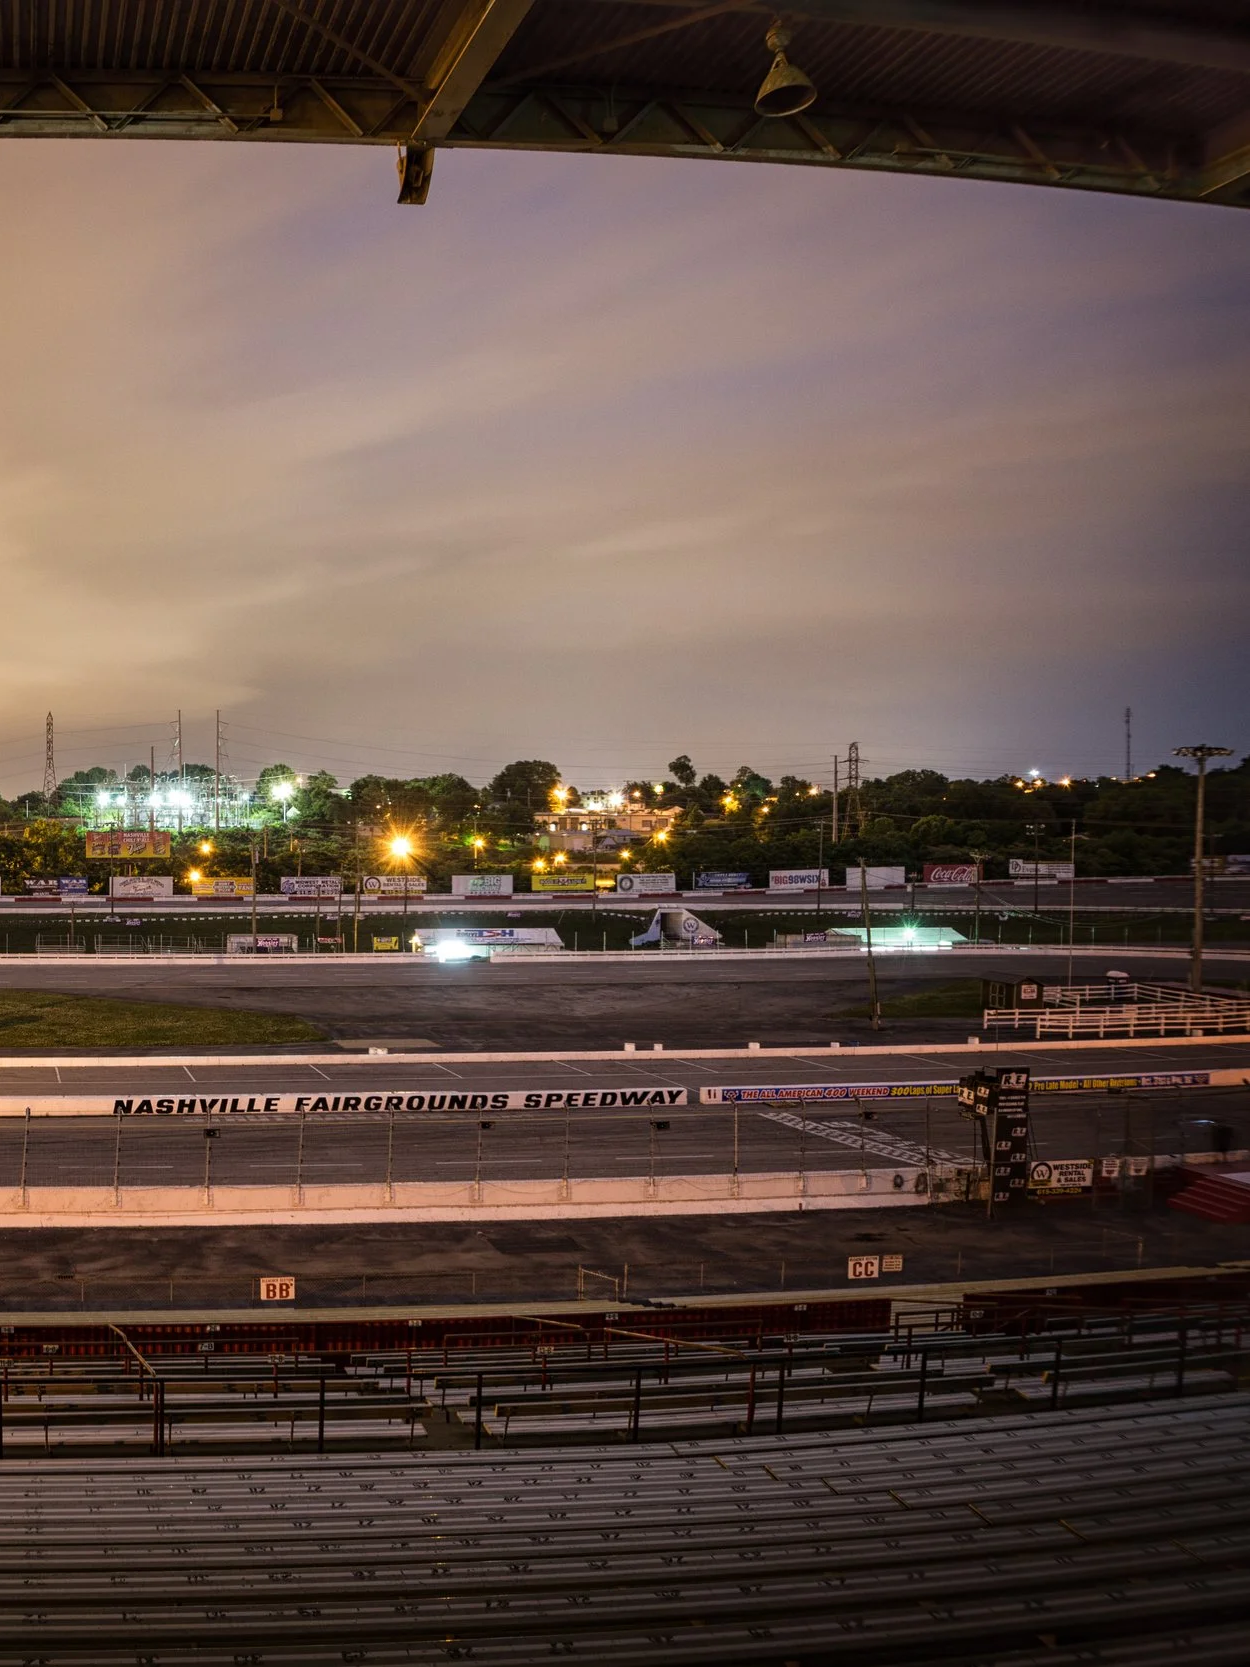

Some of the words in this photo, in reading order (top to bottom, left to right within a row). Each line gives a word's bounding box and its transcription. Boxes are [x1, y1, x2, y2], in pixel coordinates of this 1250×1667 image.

[741, 1090, 759, 1099] THE
[760, 1089, 776, 1098] ALL
[777, 1088, 823, 1099] AMERICAN
[824, 1088, 847, 1097] 400
[849, 1087, 890, 1098] WEEKEND
[113, 1097, 278, 1115] NASHVILLE
[296, 1093, 508, 1112] FAIRGROUNDS
[523, 1089, 684, 1108] SPEEDWAY
[853, 1262, 874, 1277] CC
[266, 1283, 290, 1299] BB
